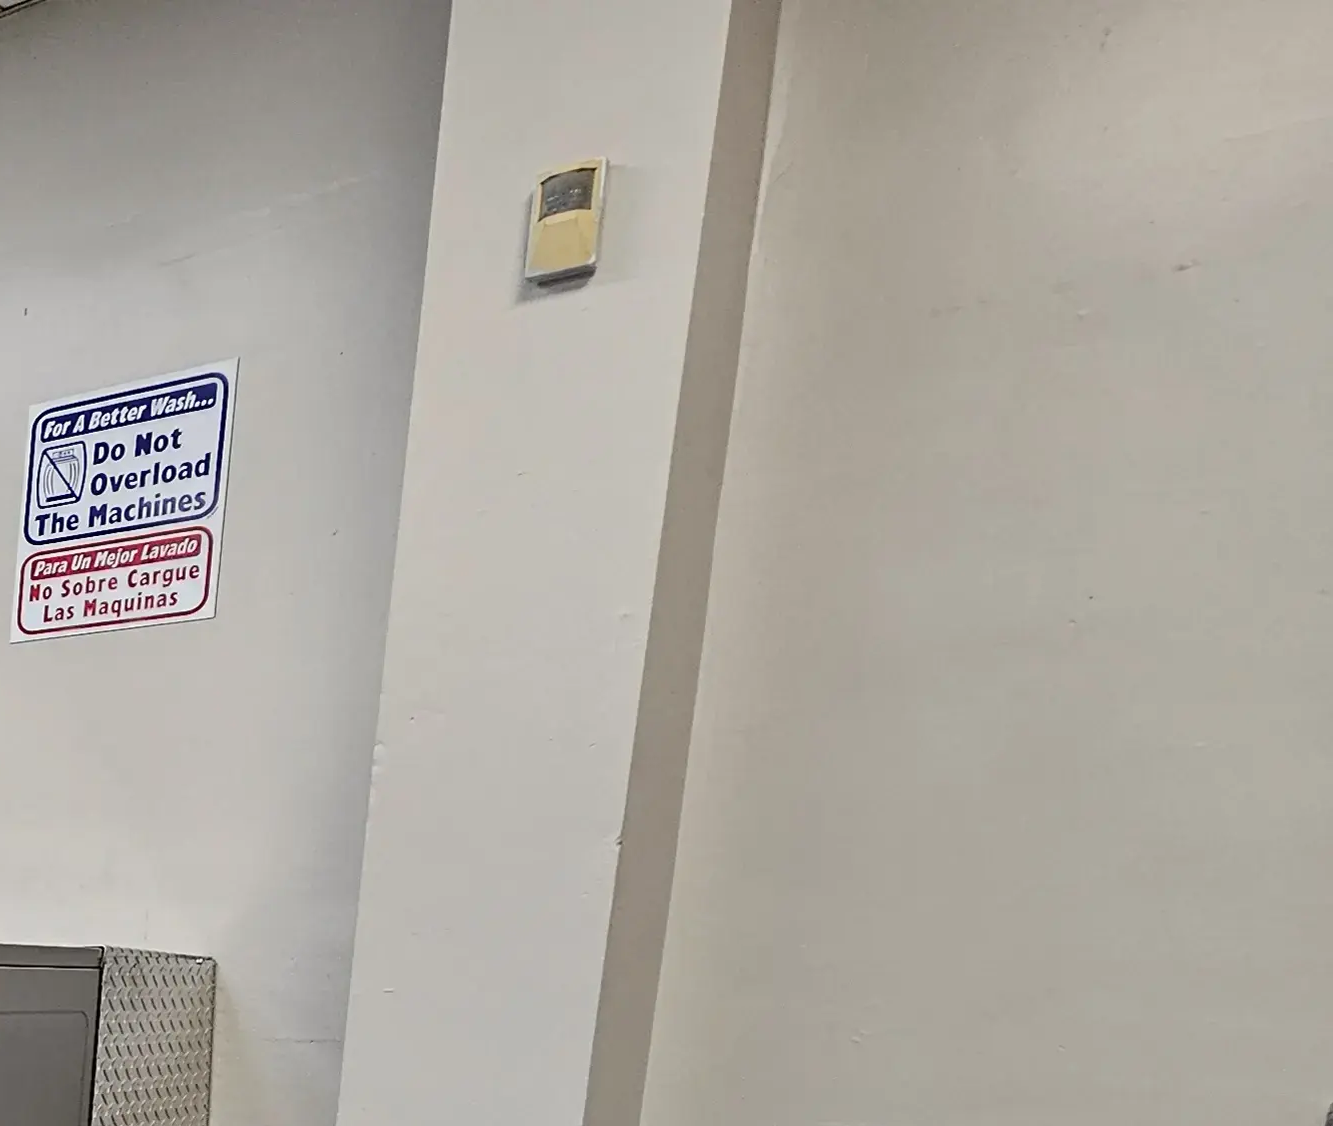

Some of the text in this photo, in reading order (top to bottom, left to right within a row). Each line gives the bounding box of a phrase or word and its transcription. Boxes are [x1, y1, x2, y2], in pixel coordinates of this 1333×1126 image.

[43, 390, 214, 440] For A Better Wash...
[93, 428, 182, 465] Do Not
[90, 452, 210, 496] Overload
[34, 491, 206, 537] The Machines
[34, 538, 198, 577] Para Un Mejor Lavado
[29, 564, 200, 602] No Sobre Cargue
[43, 591, 178, 623] Las Maquinas
